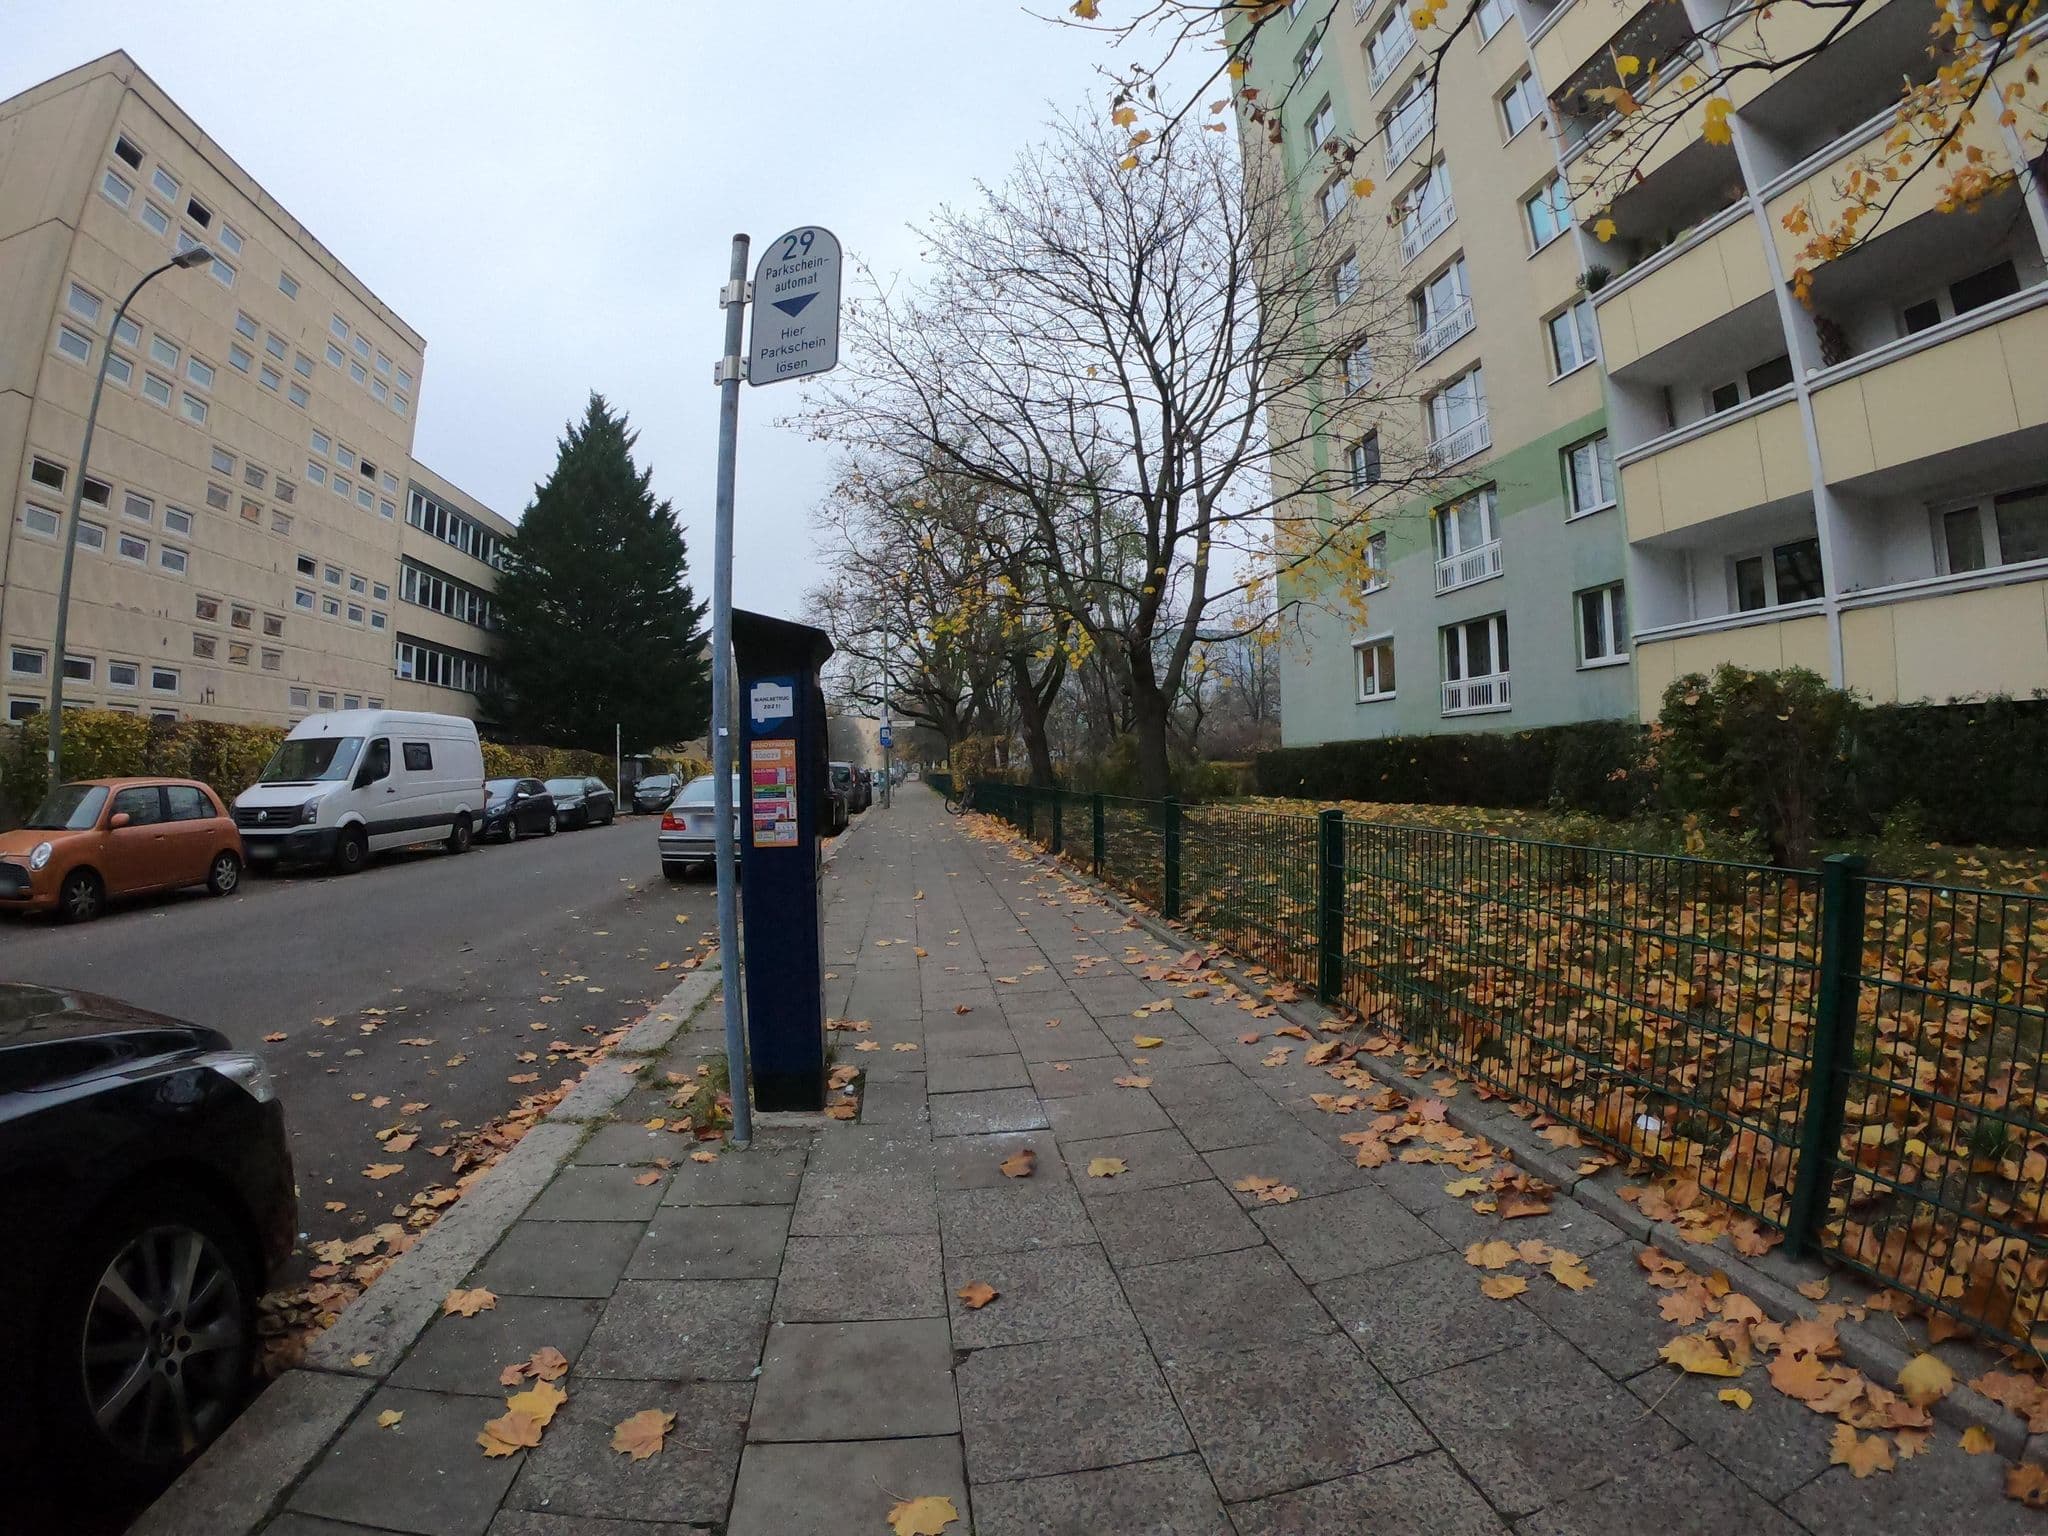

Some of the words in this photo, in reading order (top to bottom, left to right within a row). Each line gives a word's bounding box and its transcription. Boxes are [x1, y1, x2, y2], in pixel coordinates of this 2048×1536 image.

[782, 230, 815, 261] 29
[765, 257, 830, 280] Parkschein-
[774, 272, 818, 293] automat
[781, 326, 806, 339] Hier
[760, 336, 826, 360] Parkschein
[776, 358, 808, 374] lösen
